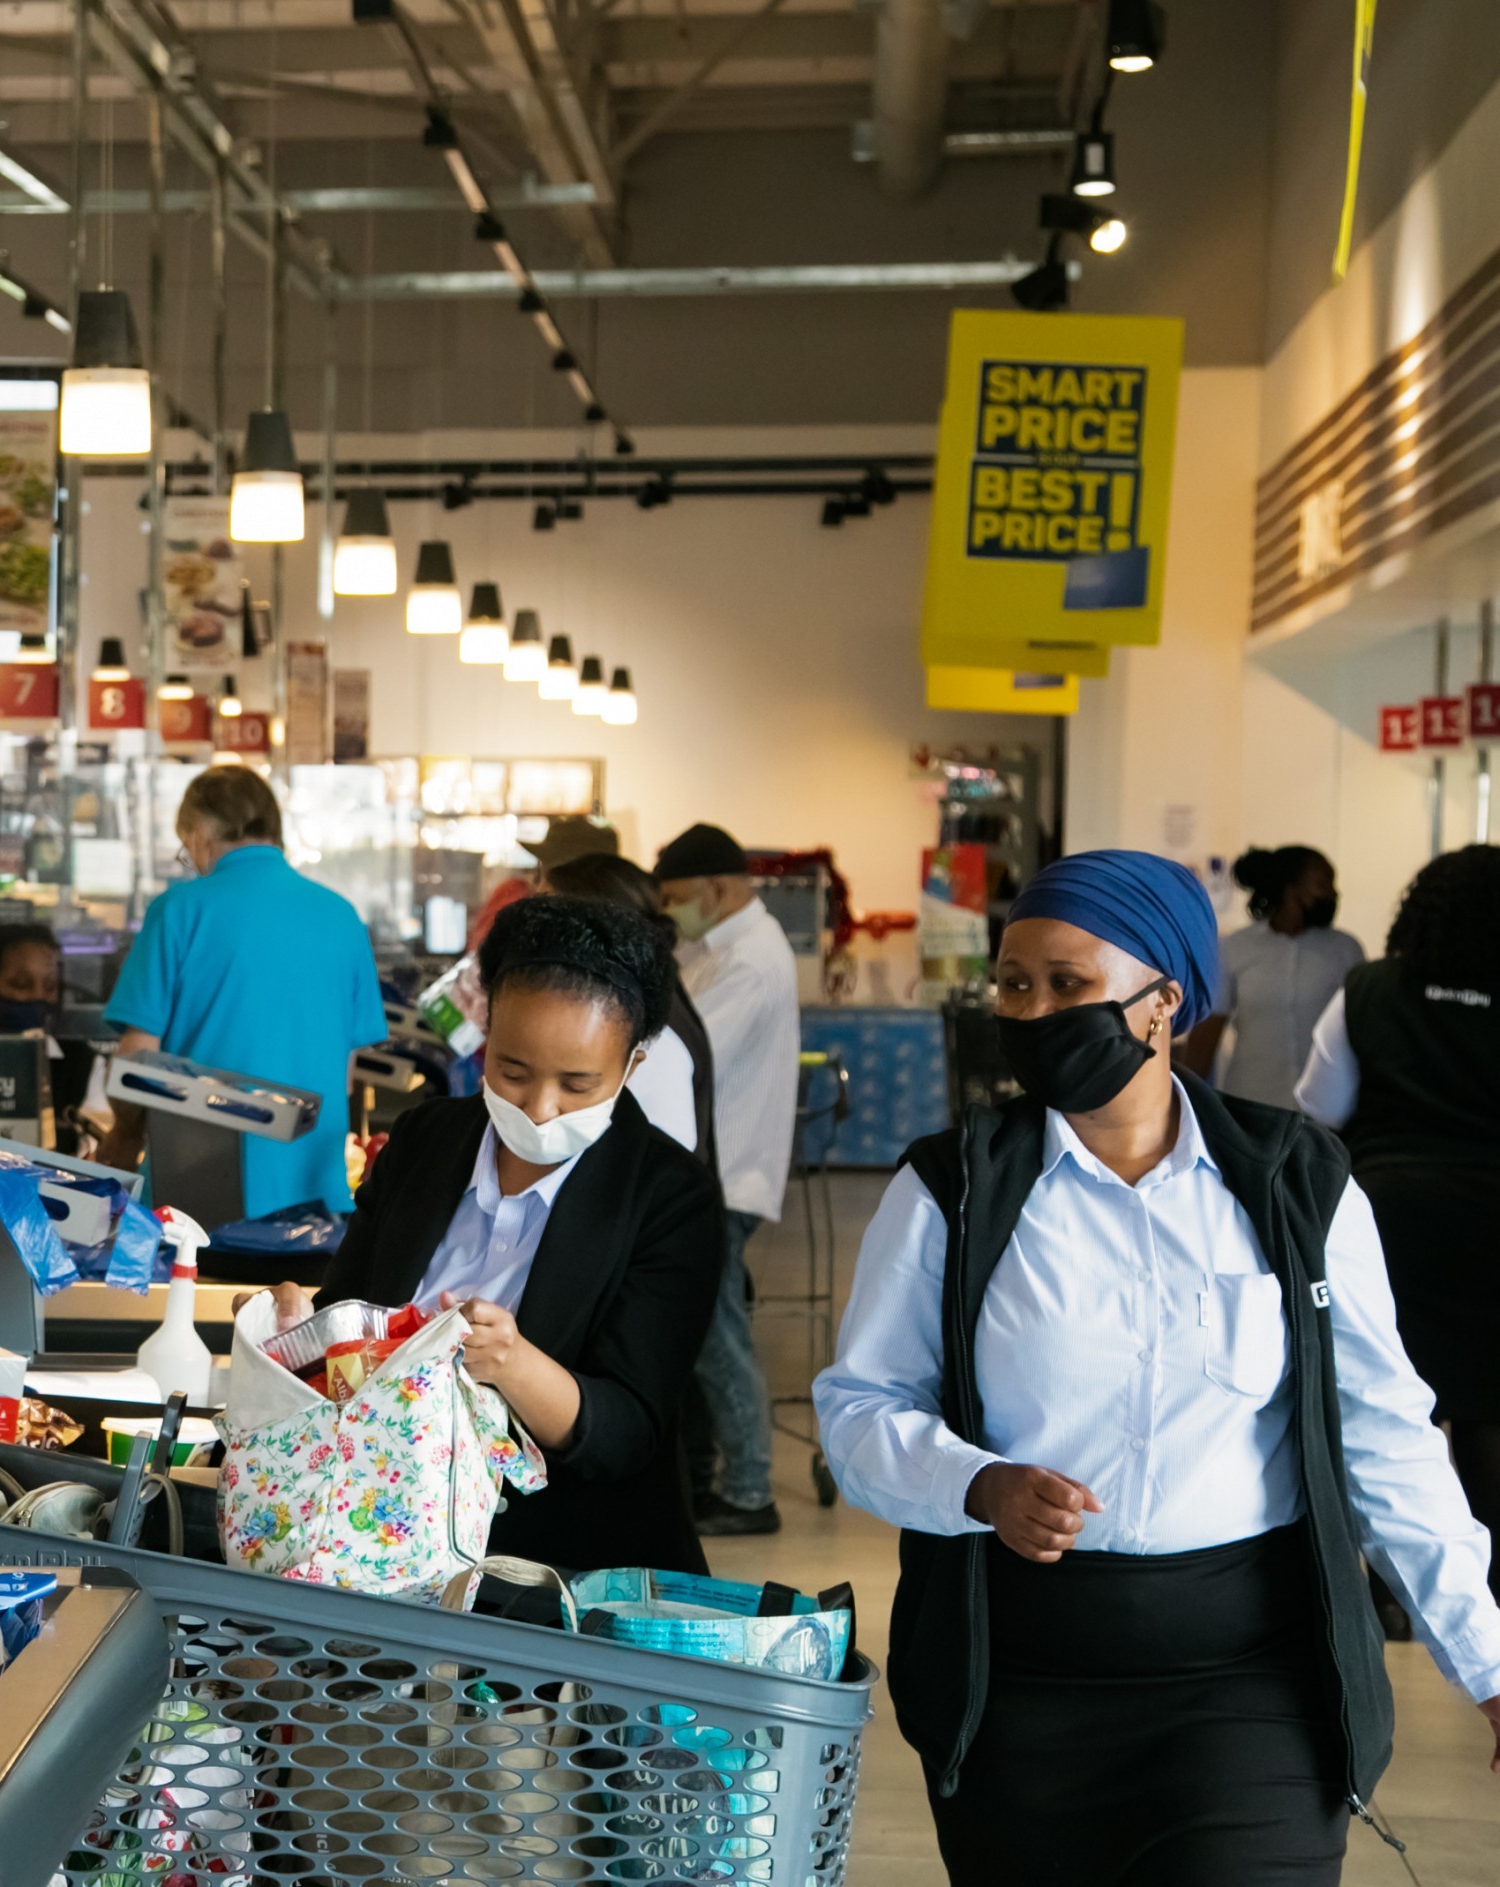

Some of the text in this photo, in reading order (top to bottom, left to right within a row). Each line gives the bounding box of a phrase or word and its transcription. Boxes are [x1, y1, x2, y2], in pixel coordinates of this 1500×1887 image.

[986, 366, 1142, 408] SMART
[981, 405, 1139, 454] PRICE
[974, 467, 1107, 514] BEST
[13, 672, 36, 706] 7
[100, 687, 125, 720] 8
[333, 1377, 347, 1401] Alb
